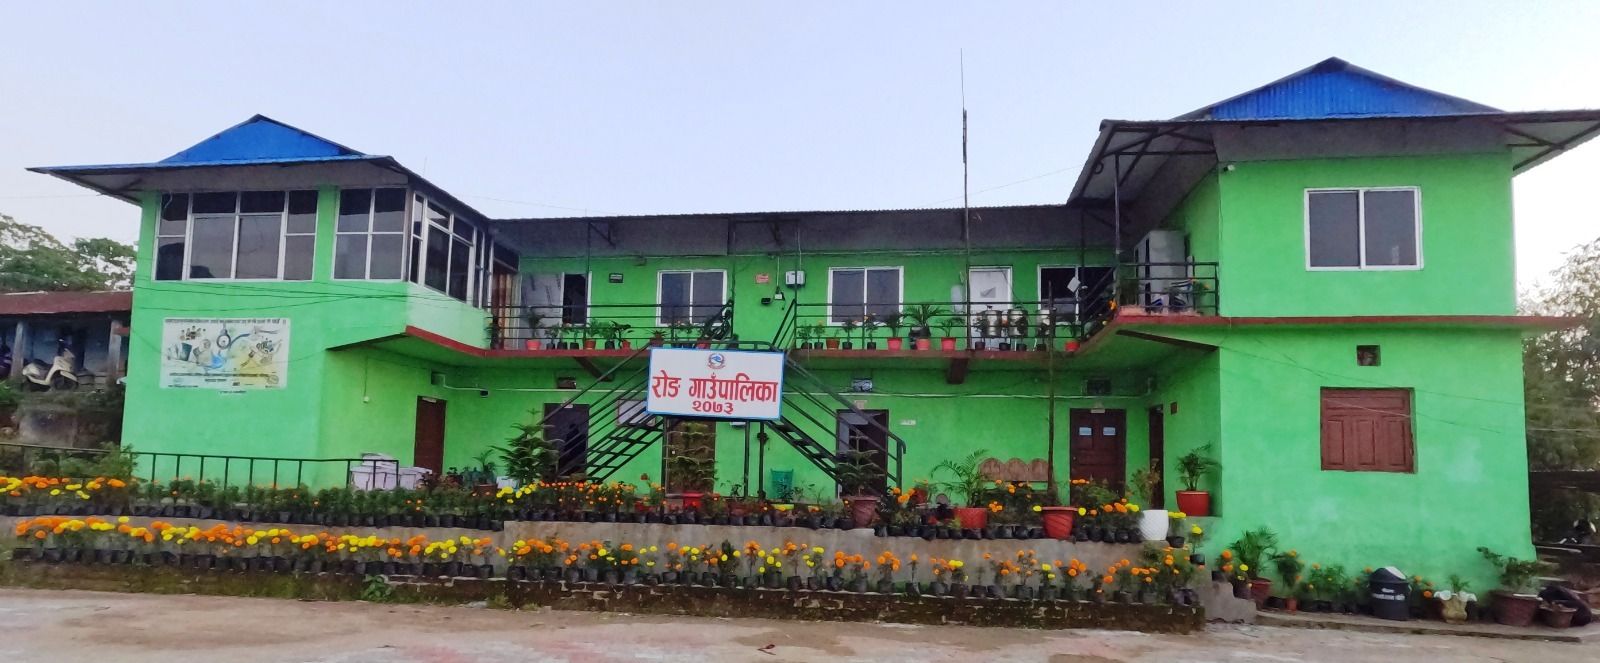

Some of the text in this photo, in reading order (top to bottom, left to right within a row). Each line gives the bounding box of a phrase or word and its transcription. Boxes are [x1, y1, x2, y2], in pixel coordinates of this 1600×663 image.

[652, 370, 778, 402] रोङ गाउँपालिका
[692, 401, 734, 414] २०७३
